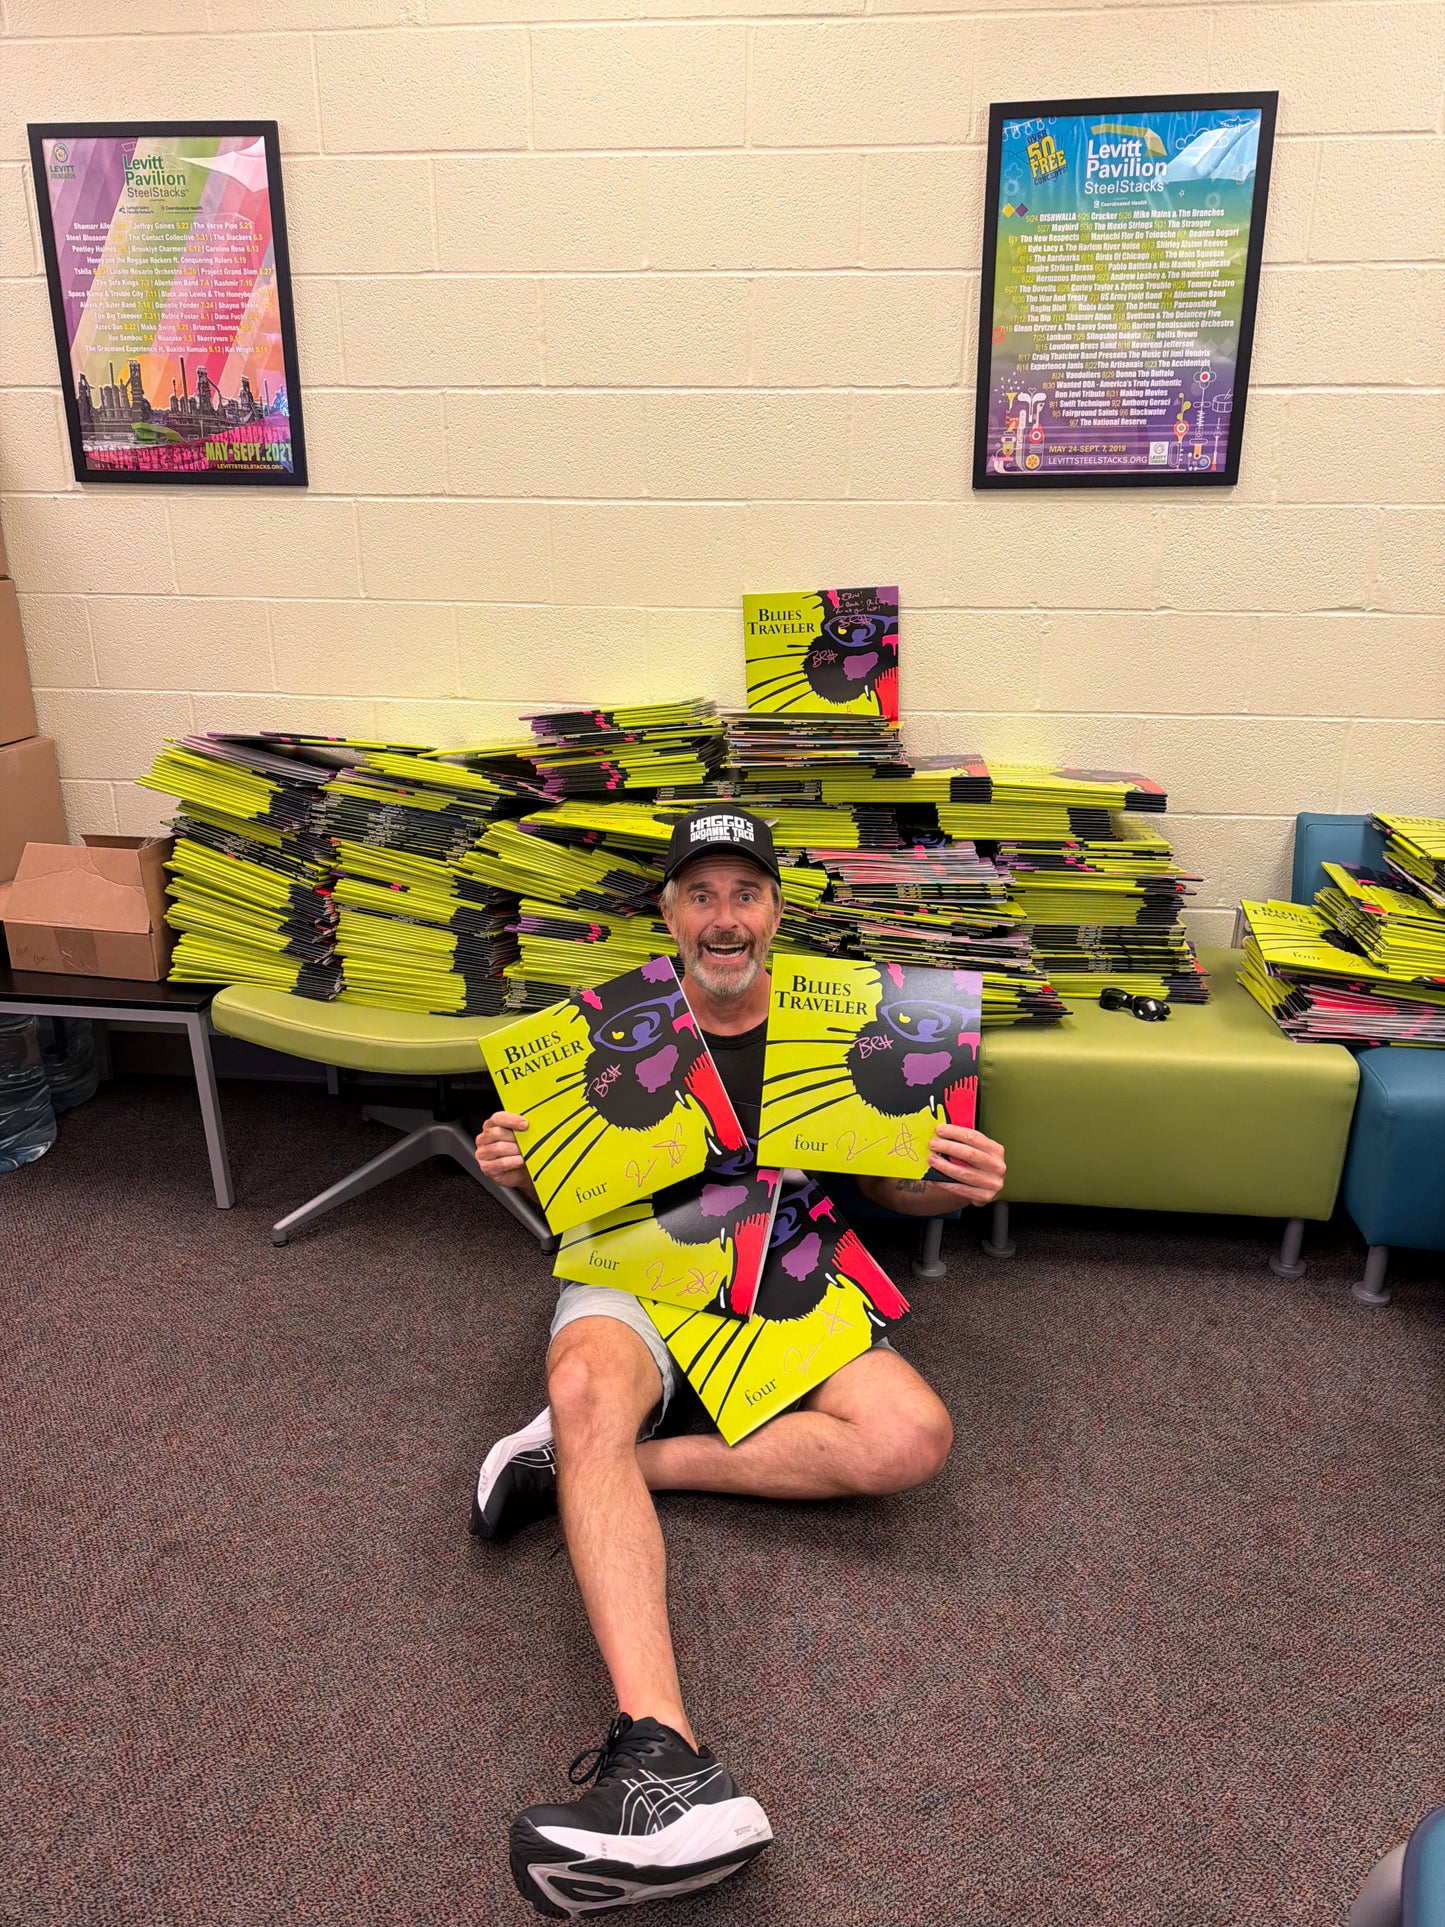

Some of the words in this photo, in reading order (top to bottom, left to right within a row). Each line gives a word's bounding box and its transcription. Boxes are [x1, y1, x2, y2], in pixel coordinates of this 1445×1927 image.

[1027, 130, 1047, 143] OVER
[1027, 136, 1055, 161] 50
[1089, 139, 1142, 159] Levitt
[122, 154, 163, 170] Levitt
[1030, 150, 1066, 178] FREE
[1086, 158, 1167, 178] Pavilion
[125, 171, 186, 186] Pavilion
[1034, 166, 1069, 185] CONCERTS!
[127, 187, 186, 198] SteelStacks
[1085, 180, 1164, 194] SteelStacks
[1040, 213, 1076, 222] DISHWALLA
[1091, 212, 1118, 220] Cracker
[1151, 210, 1171, 218] Mains
[1179, 209, 1191, 217] The
[155, 222, 174, 230] Gaines
[1052, 223, 1079, 232] Maybird
[1182, 220, 1211, 228] Stranger
[201, 268, 222, 276] Project
[1071, 284, 1092, 292] Curley
[1094, 283, 1113, 291] Taylor
[1188, 281, 1211, 289] Tommy
[1047, 333, 1071, 341] Lankum
[1032, 353, 1049, 361] Craig
[1051, 352, 1080, 360] Thatcher
[1142, 350, 1160, 358] Music
[1185, 349, 1210, 357] Hendrix
[1172, 359, 1210, 367] Accidentals
[1151, 369, 1174, 377] Buffalo
[1134, 380, 1149, 388] Truly
[1151, 379, 1182, 387] Authentic
[1069, 390, 1081, 398] Jovi
[1082, 390, 1105, 398] Tribute
[1120, 390, 1142, 398] Making
[1078, 400, 1110, 408] Technique
[1122, 399, 1147, 407] Anthony
[1149, 398, 1170, 406] Geraci
[1062, 410, 1096, 418] Fairground
[1048, 456, 1147, 465] LEVITTSTEELSTACKS.ORG
[759, 609, 802, 621] BLUES
[747, 622, 815, 635] TRAVELER
[690, 815, 753, 833] HAGGO'S
[690, 827, 730, 842] ORGANIC
[732, 828, 754, 842] TACO
[1248, 908, 1325, 927] TRAVELER
[1261, 907, 1309, 920] BLUES
[1293, 951, 1322, 960] four
[792, 975, 852, 997] BLUES
[775, 990, 869, 1016] TRAVELER
[504, 1030, 562, 1065] BLUES
[495, 1039, 585, 1086] TRAVELER
[794, 1134, 829, 1152] four
[575, 1182, 608, 1203] four
[588, 1250, 620, 1271] four
[744, 1378, 776, 1406] four
